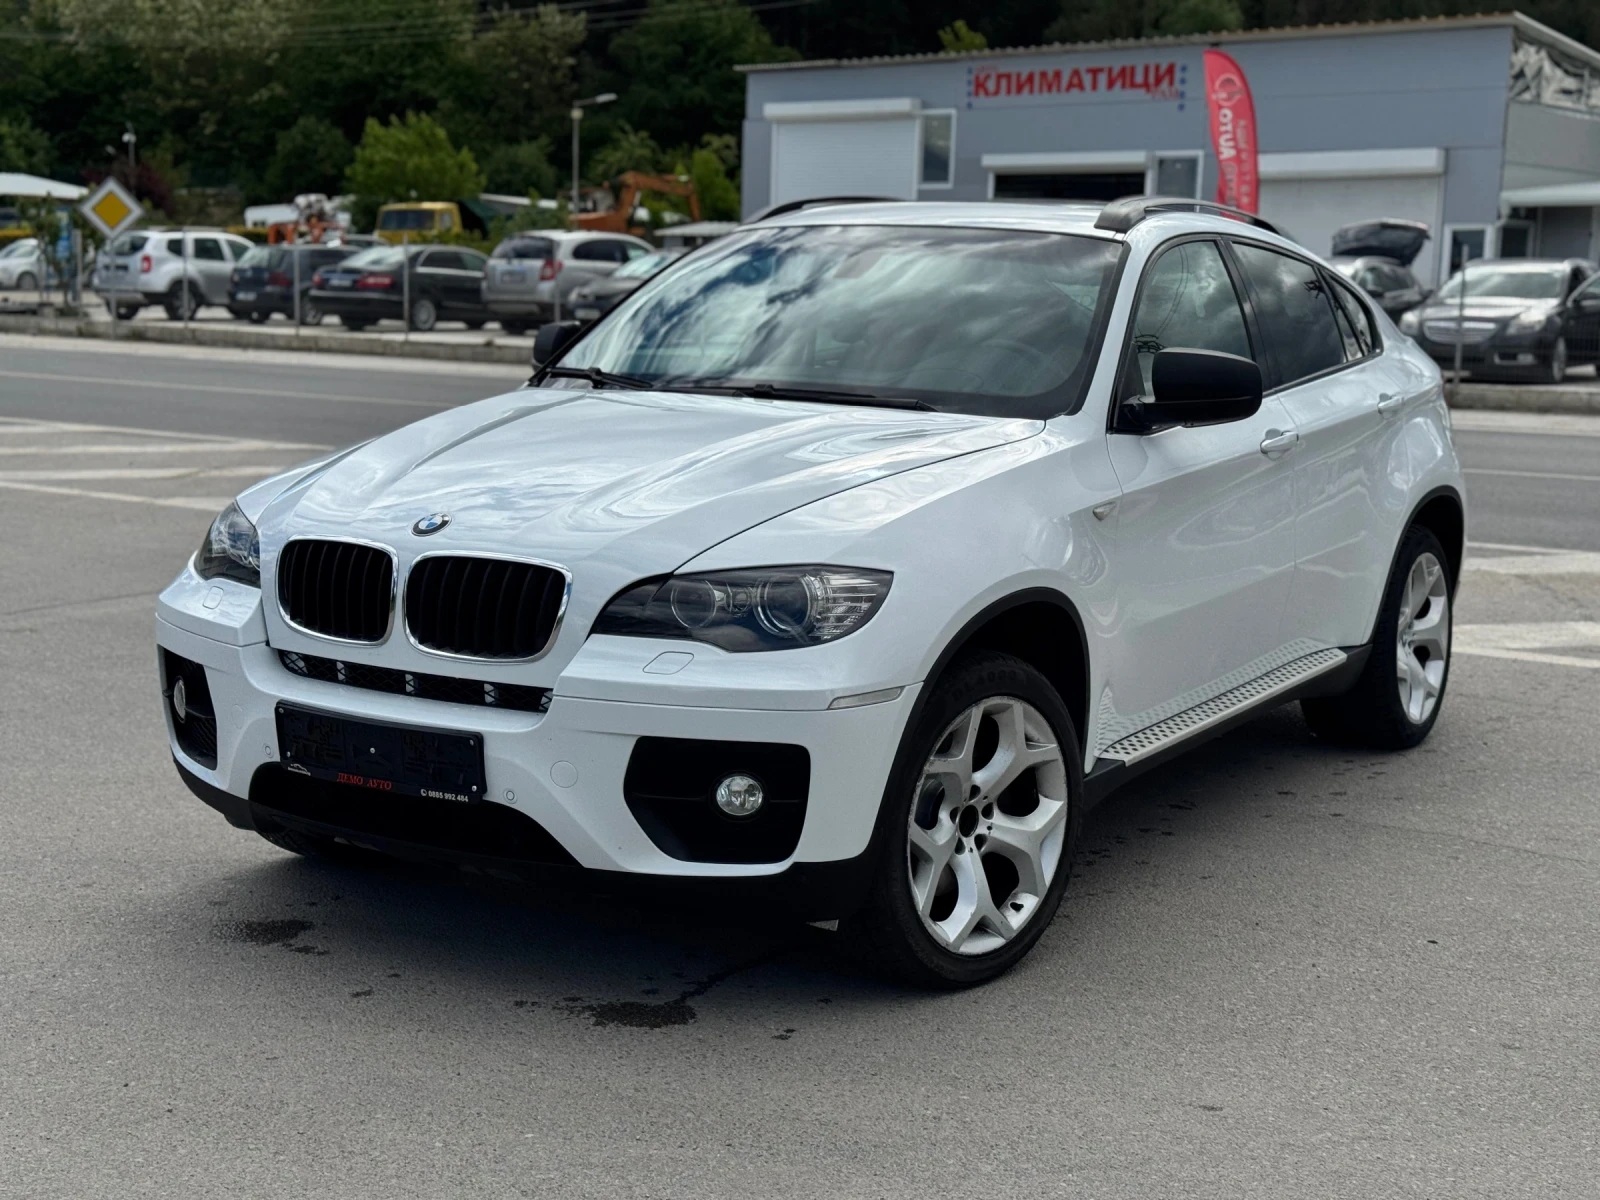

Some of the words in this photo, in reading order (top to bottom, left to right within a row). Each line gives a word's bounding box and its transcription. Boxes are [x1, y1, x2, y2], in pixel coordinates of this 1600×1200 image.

[973, 62, 1177, 98] КЛИМАТИЦИ
[336, 773, 363, 786] ДЕМО
[367, 779, 392, 790] АУТО
